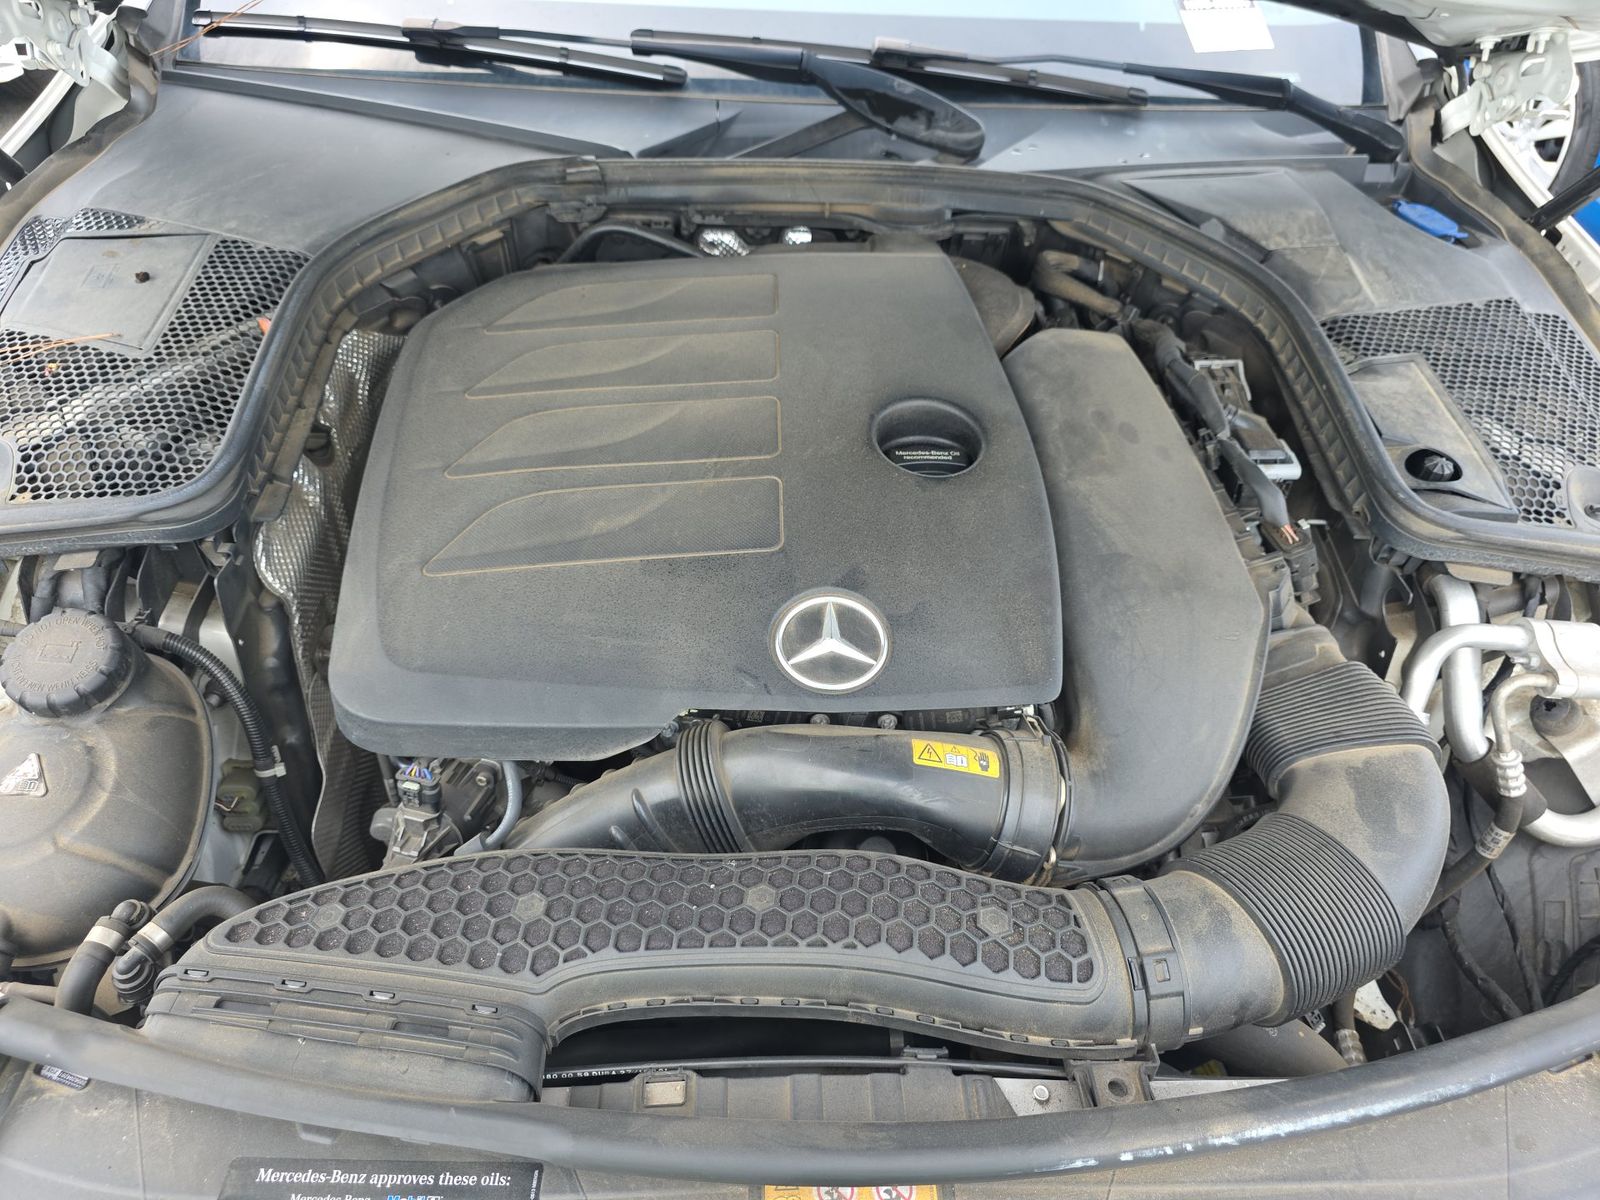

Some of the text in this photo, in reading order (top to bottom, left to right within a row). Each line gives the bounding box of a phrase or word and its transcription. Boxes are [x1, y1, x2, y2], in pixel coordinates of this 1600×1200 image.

[56, 616, 80, 626] OPEN
[75, 659, 98, 681] HEISS
[256, 1168, 511, 1187] Mercedes-Benz approves these oils:
